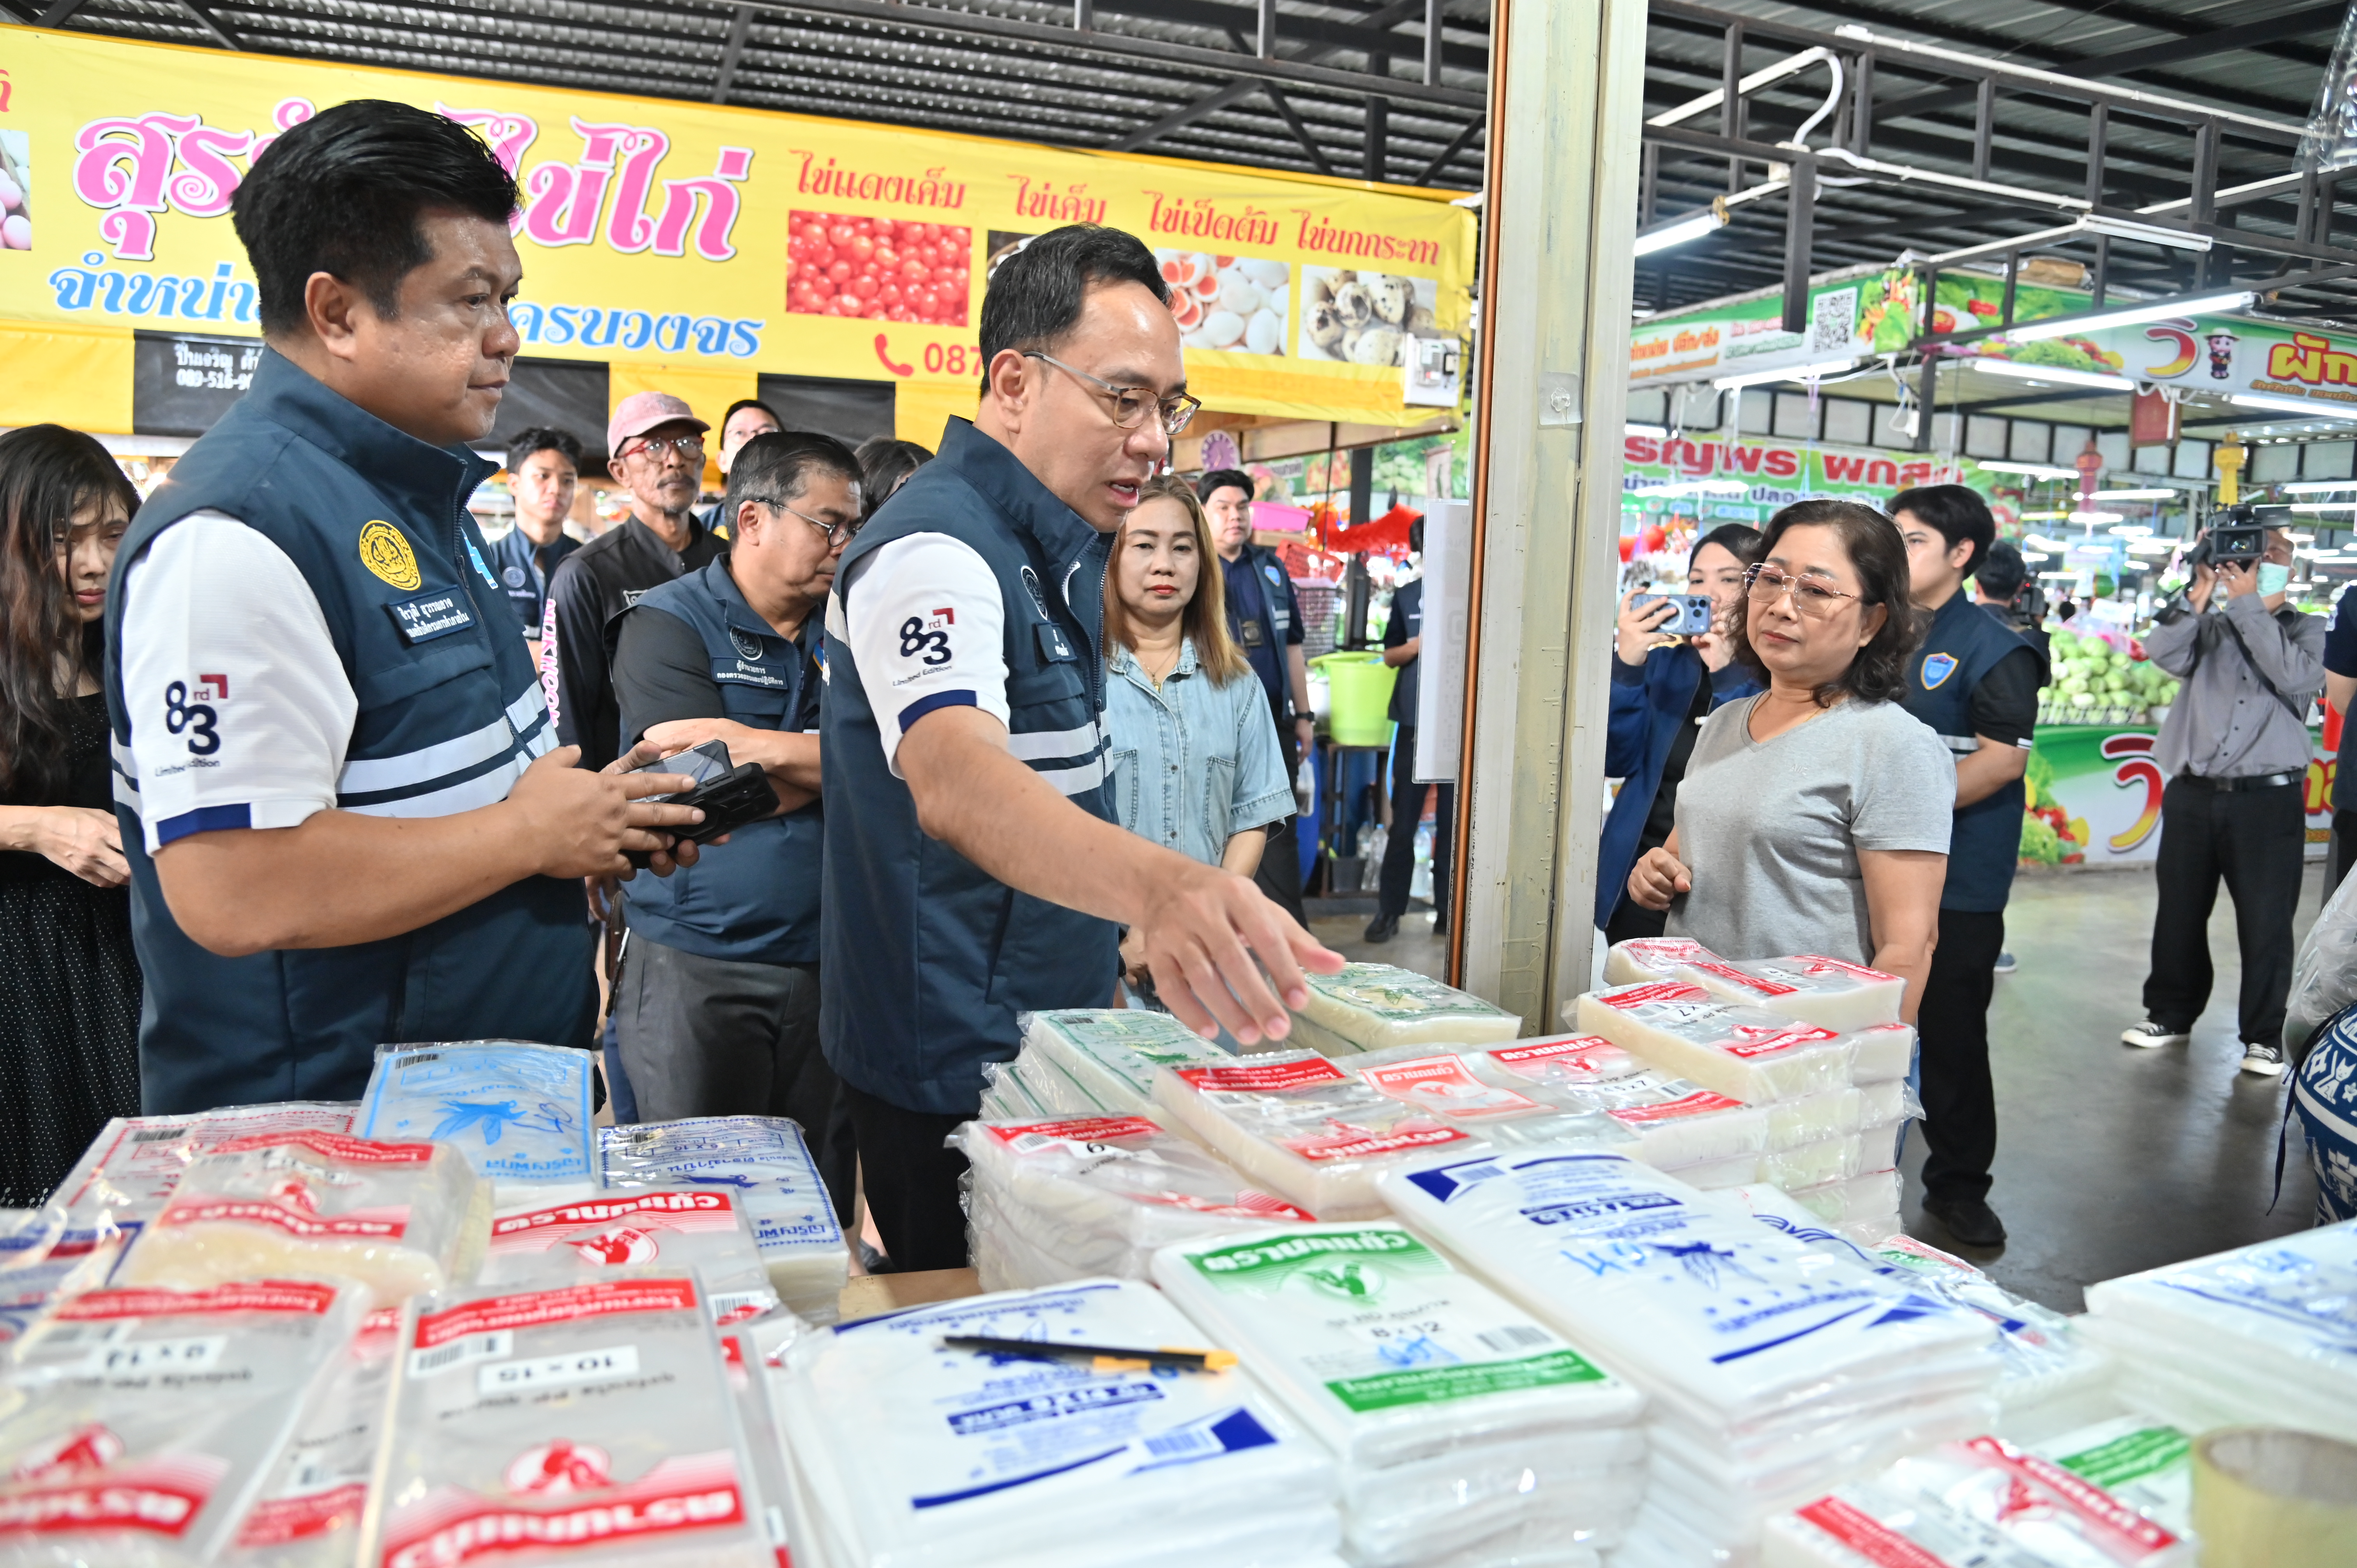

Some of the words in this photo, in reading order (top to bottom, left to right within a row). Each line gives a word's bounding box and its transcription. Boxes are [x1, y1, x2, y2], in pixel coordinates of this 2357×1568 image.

[789, 149, 966, 209] ไข่แดงเค็ม
[1008, 174, 1107, 225] ไข่เค็ม
[1142, 190, 1279, 245] ไข่เป็ดต้ม
[1292, 208, 1440, 266] ไข่นกกระทา
[48, 253, 260, 323] จำหน่า
[922, 665, 952, 676] Edition
[1501, 1038, 1604, 1060] ตรานกแก้ว
[498, 1192, 720, 1233] ตรานกแก้ว
[1202, 1231, 1409, 1272] ตรานกแก้ว
[497, 1367, 532, 1381] 15
[577, 1354, 615, 1371] 10
